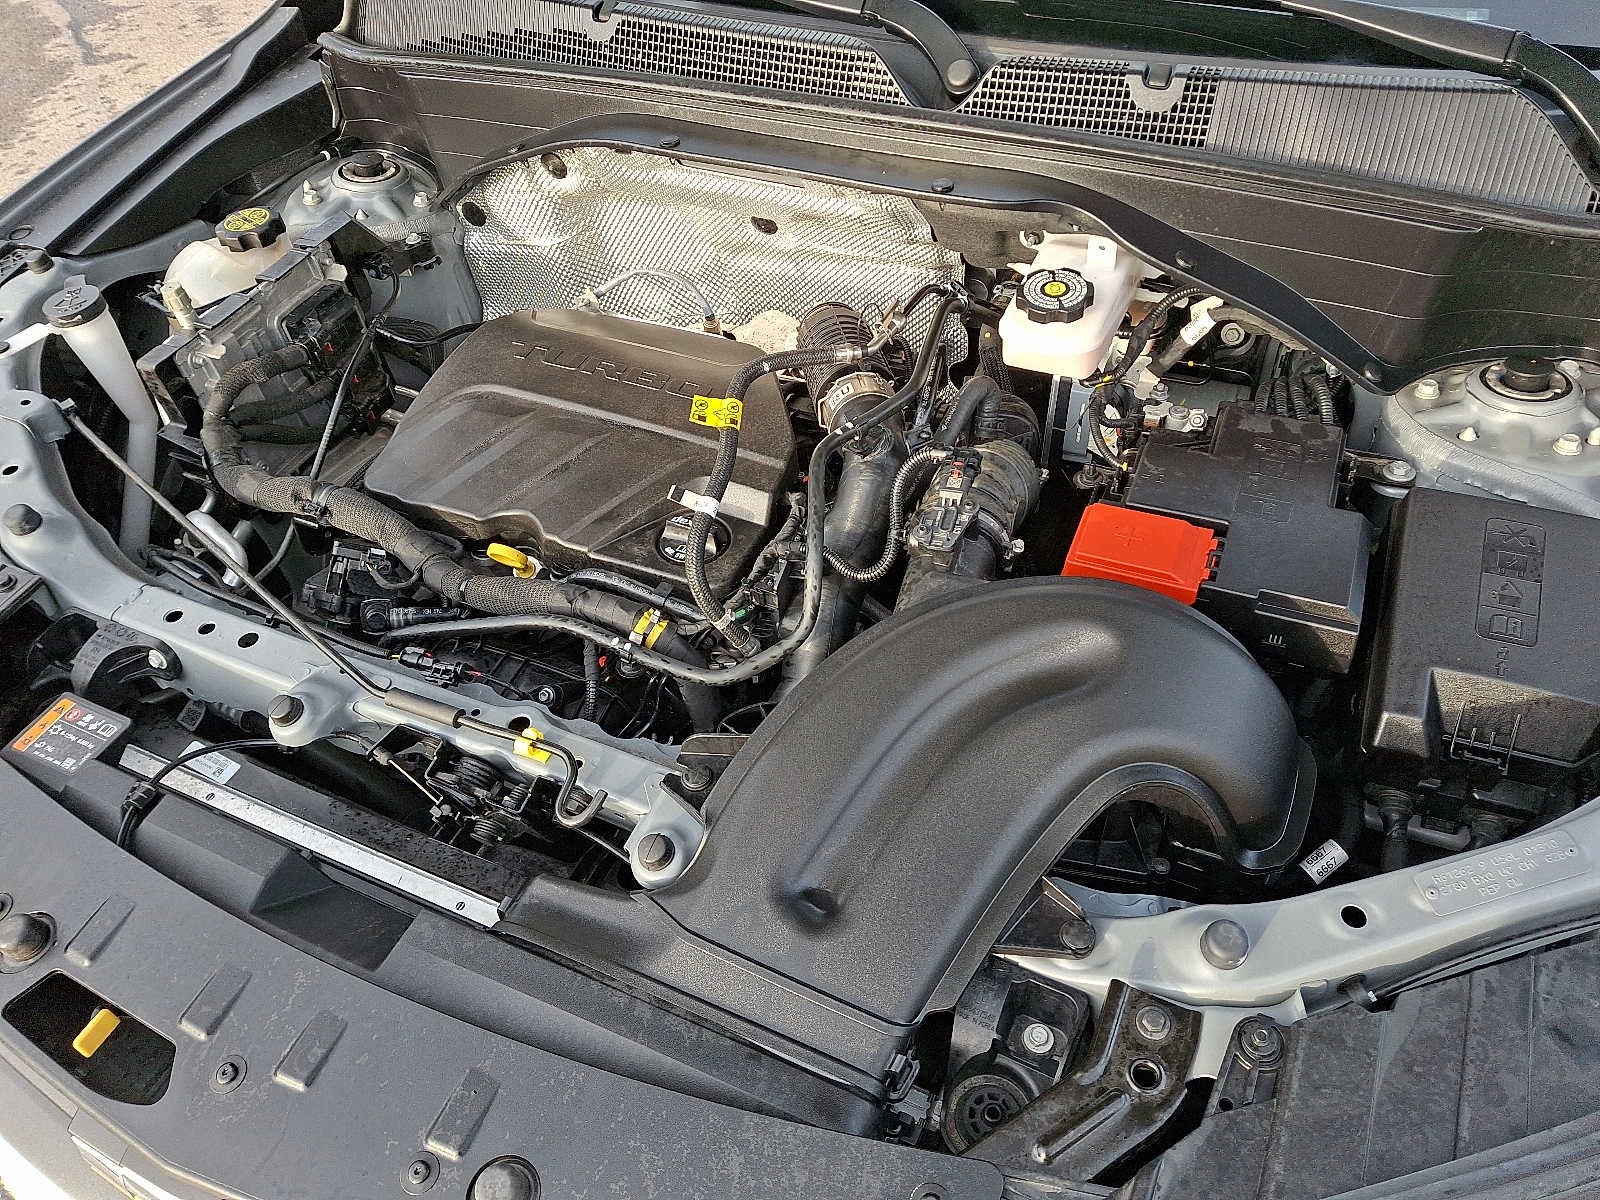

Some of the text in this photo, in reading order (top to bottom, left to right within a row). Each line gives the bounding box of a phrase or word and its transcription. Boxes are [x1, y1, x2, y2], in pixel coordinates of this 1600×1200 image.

[511, 341, 713, 400] TURBO
[1305, 847, 1327, 866] 6667
[1316, 856, 1337, 877] 6667
